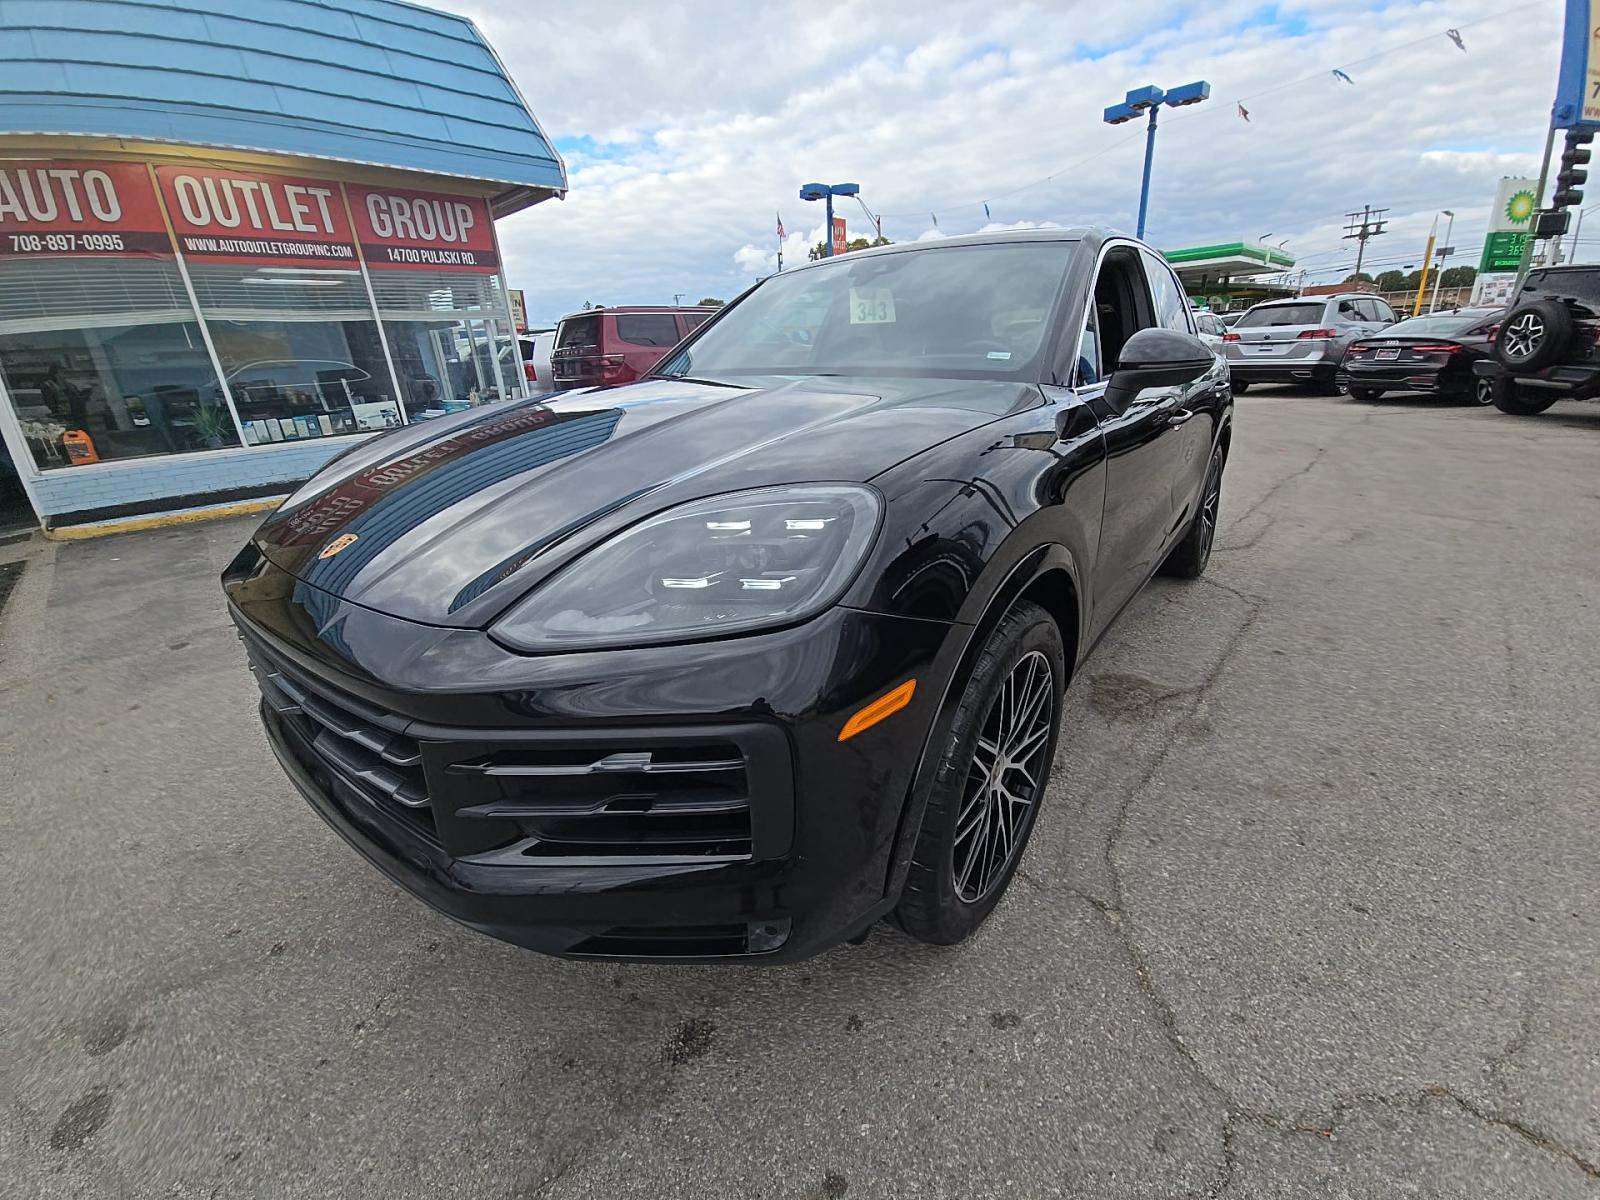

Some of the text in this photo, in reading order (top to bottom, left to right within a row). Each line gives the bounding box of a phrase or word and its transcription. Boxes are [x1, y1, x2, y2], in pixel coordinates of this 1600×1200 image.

[0, 169, 475, 243] AUTO OUTLET GROUP
[8, 234, 124, 252] 708-897-0995
[184, 237, 354, 259] WWW.AUTOOUTLETGROUPINC.COM
[387, 247, 478, 265] 14700 PULASKI RD.
